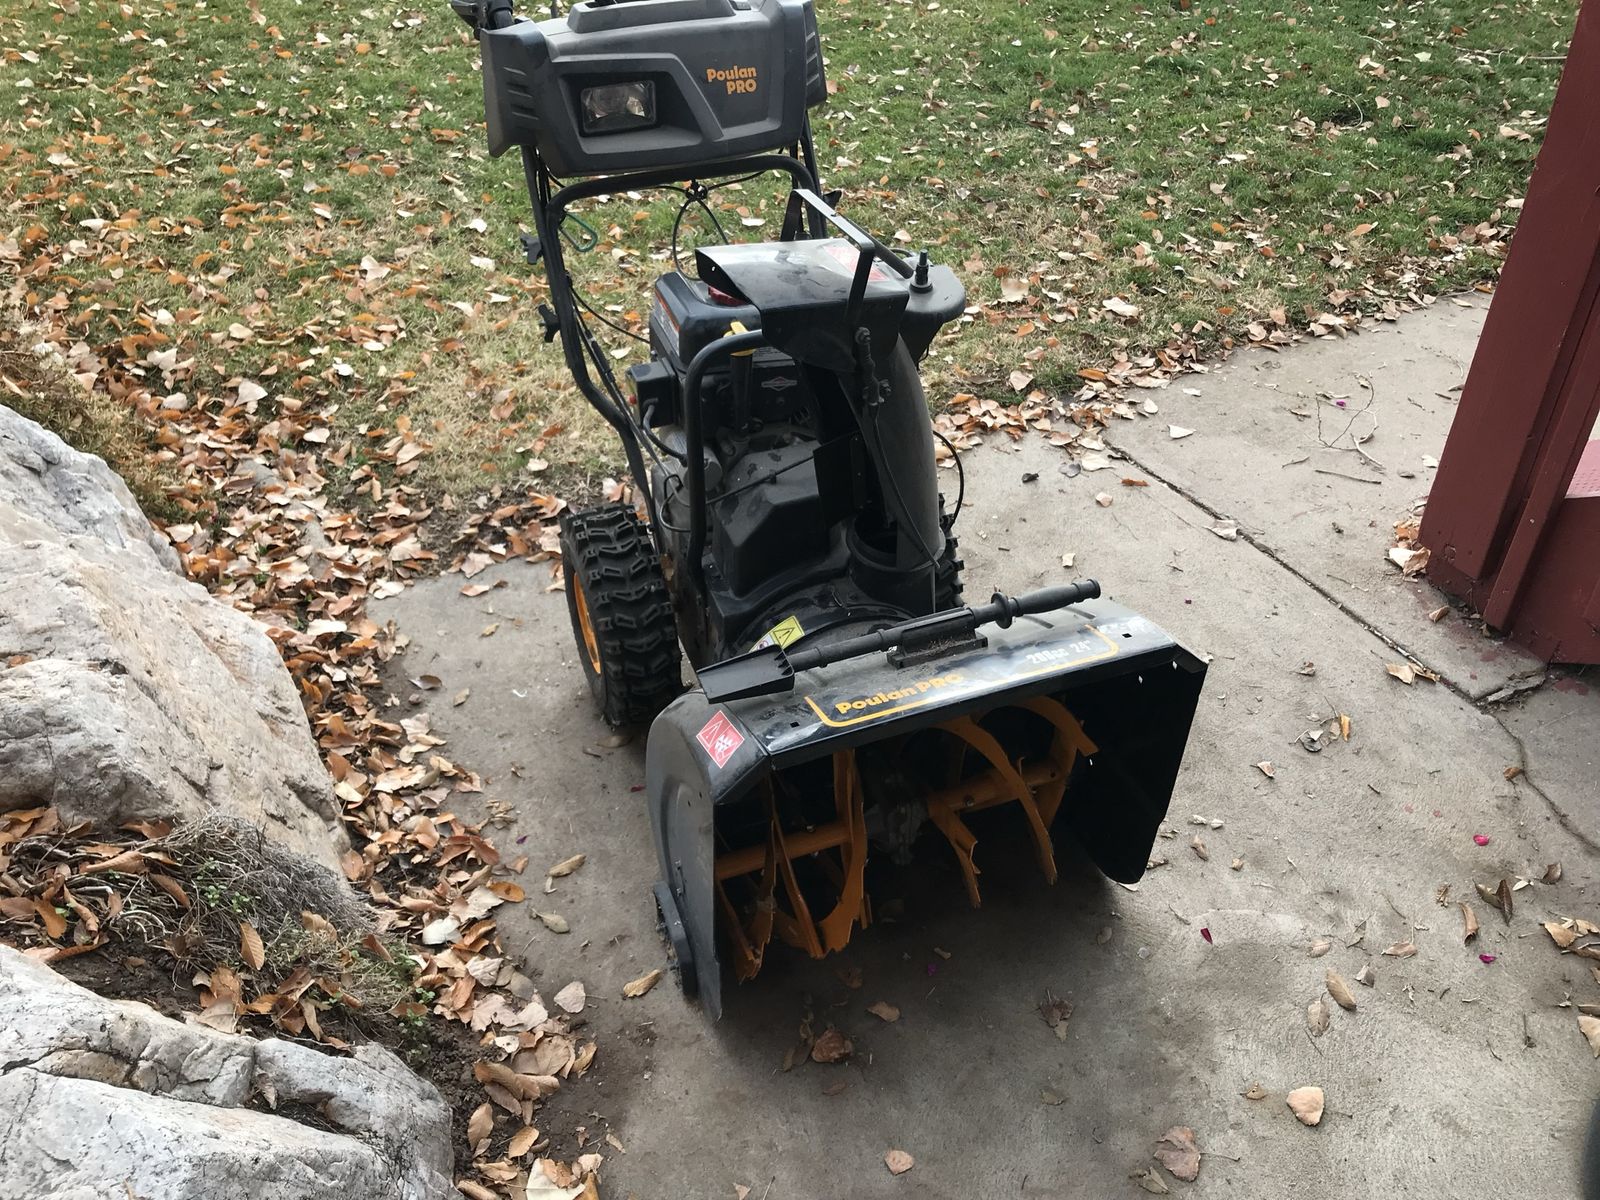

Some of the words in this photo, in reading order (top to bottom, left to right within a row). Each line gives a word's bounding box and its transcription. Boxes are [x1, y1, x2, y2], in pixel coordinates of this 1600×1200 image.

[706, 65, 757, 83] Poulan
[726, 79, 757, 95] PRO
[835, 686, 918, 714] Poulan
[914, 672, 963, 692] PRO
